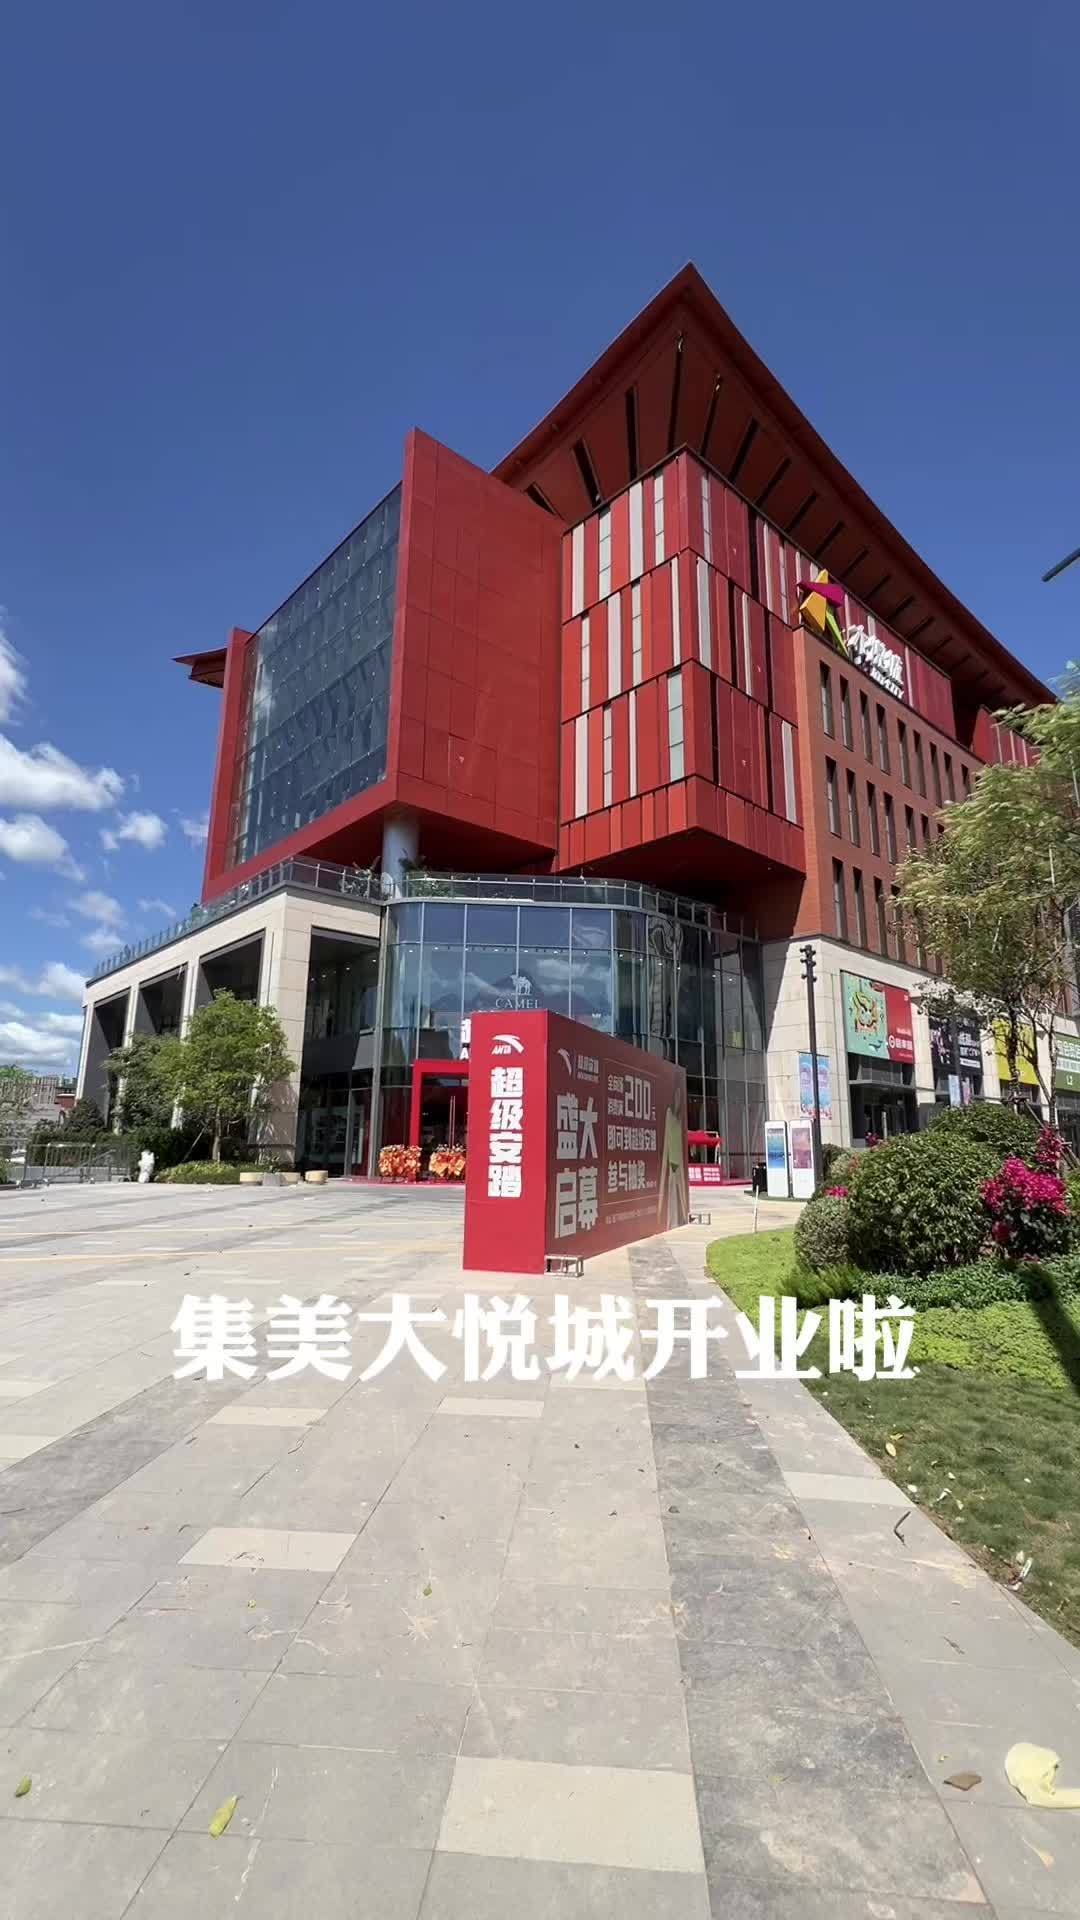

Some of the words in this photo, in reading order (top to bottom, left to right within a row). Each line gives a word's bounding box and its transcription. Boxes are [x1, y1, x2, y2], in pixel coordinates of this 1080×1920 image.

[491, 1044, 512, 1056] ANTA
[487, 1066, 524, 1198] 超级安踏
[556, 1092, 598, 1160] 盛大
[554, 1167, 598, 1239] 启幕
